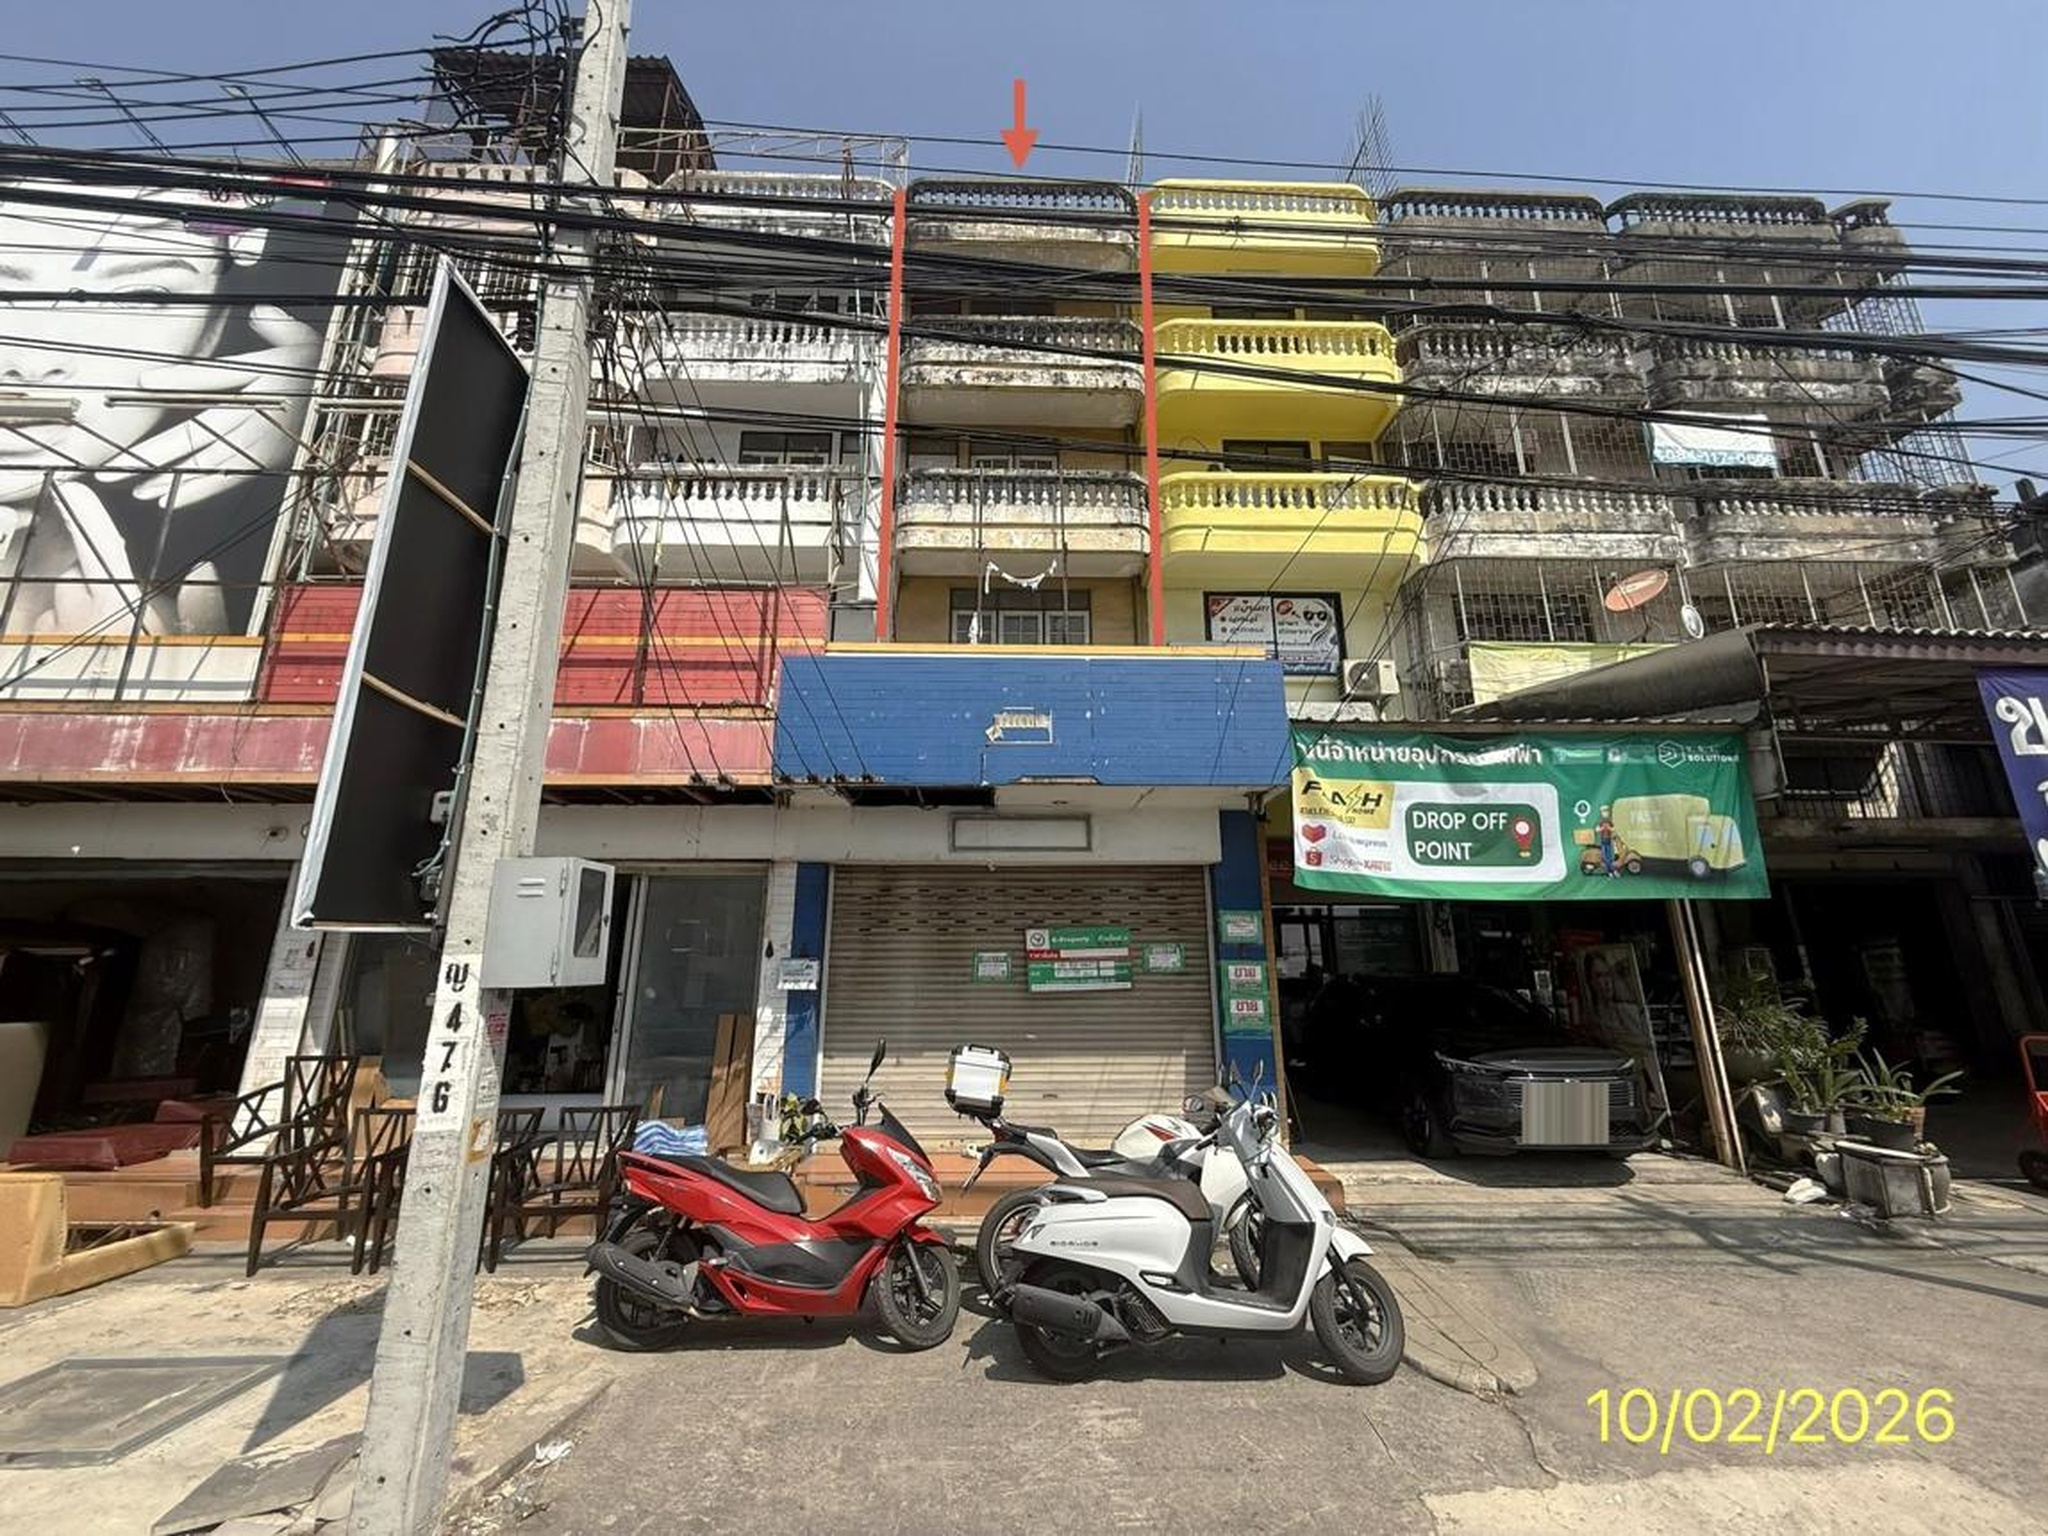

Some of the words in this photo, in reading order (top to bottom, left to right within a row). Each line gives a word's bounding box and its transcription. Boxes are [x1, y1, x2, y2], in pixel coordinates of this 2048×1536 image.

[1412, 811, 1467, 830] DROP
[1472, 812, 1508, 831] OFF
[1414, 841, 1473, 861] POINT
